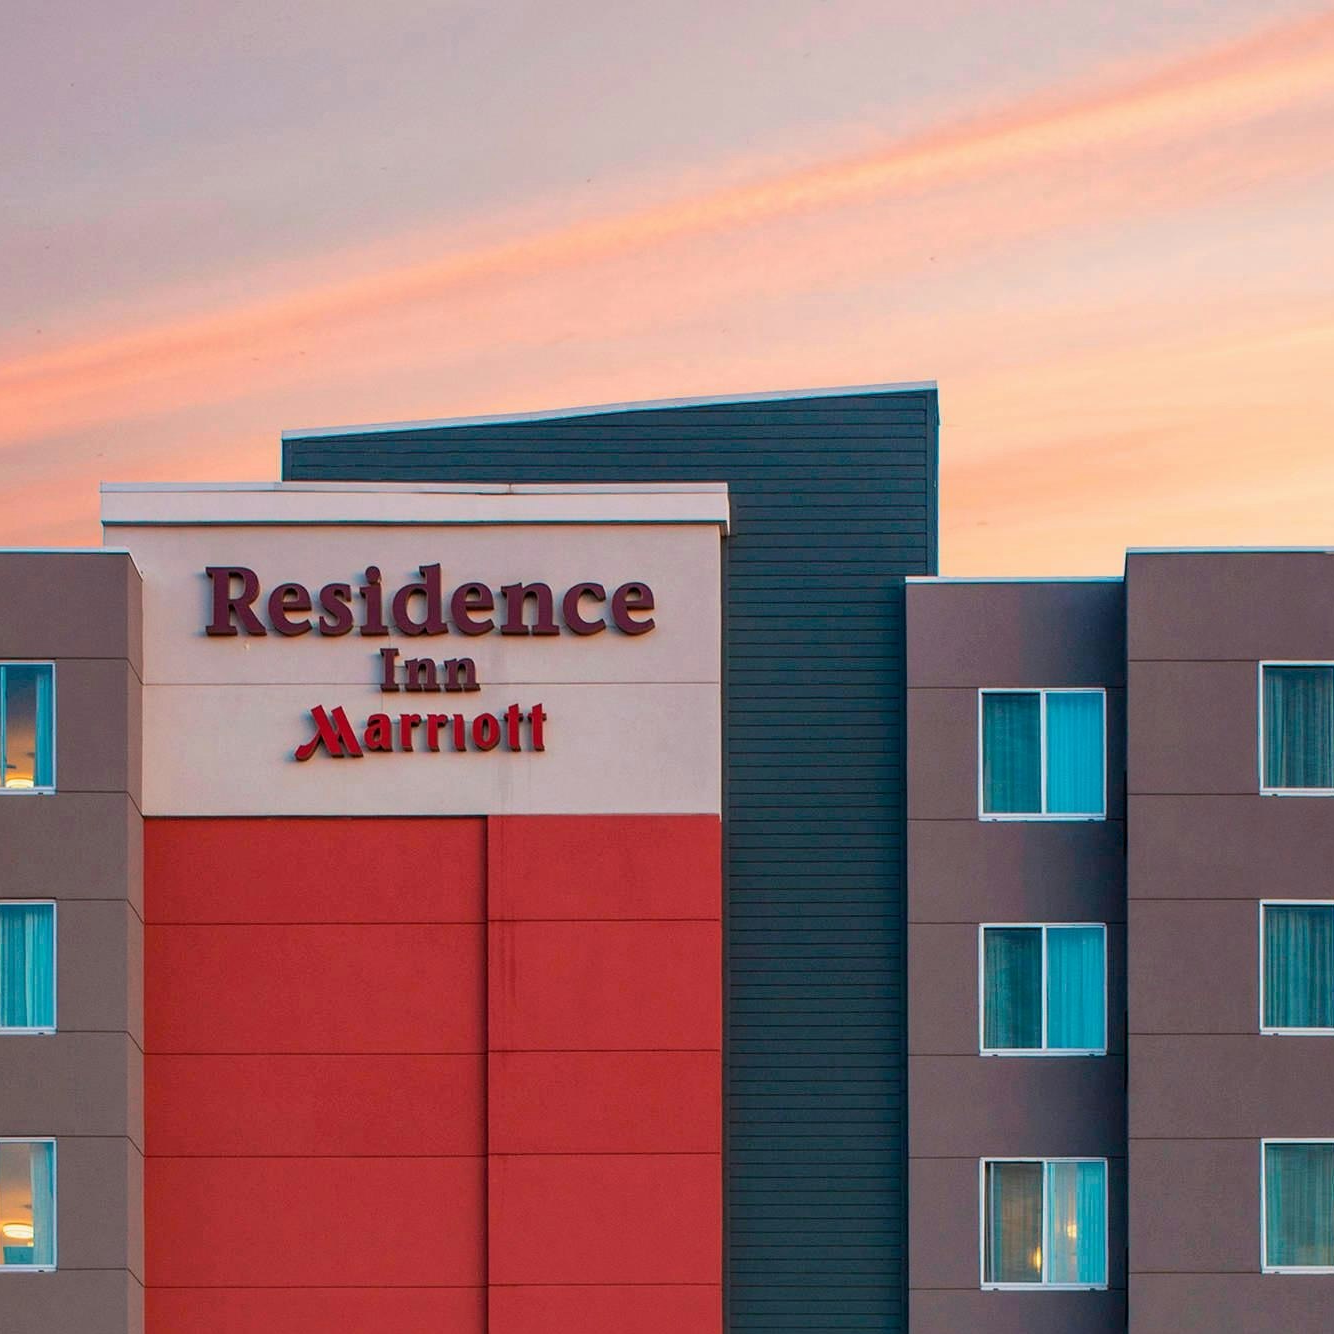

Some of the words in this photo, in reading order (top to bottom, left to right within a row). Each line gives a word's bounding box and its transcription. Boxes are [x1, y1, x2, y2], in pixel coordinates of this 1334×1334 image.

[205, 563, 656, 637] Residence
[380, 648, 481, 693] Inn
[294, 703, 547, 761] Marriott
